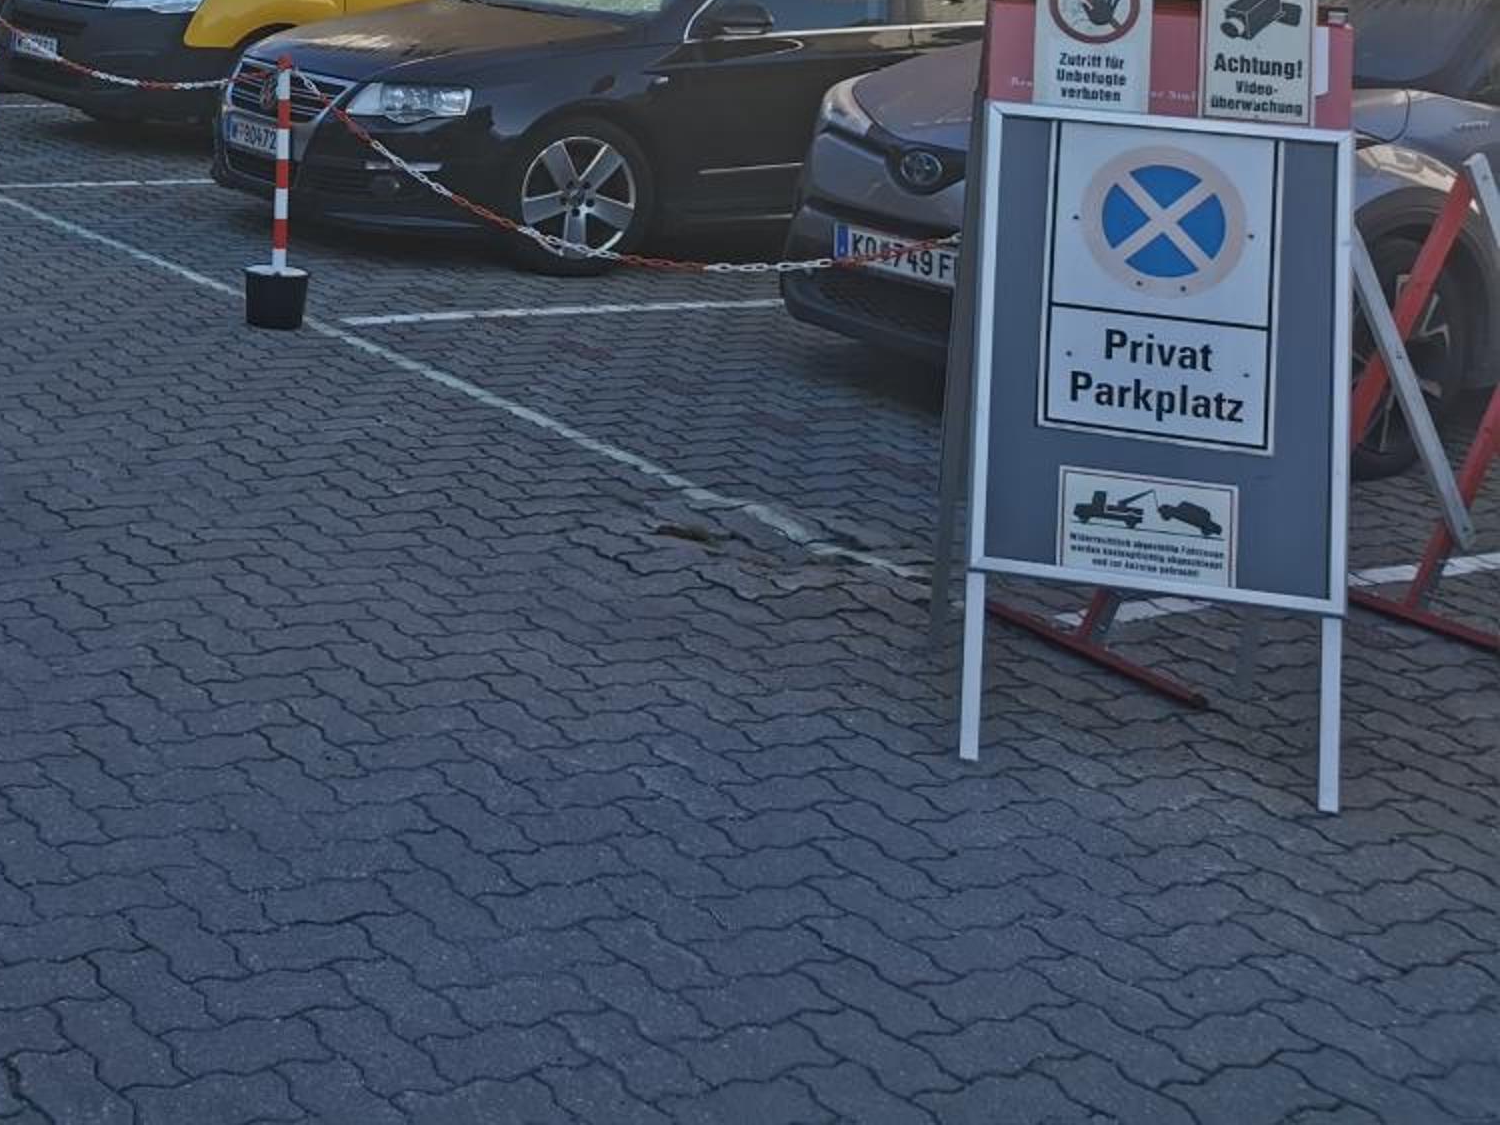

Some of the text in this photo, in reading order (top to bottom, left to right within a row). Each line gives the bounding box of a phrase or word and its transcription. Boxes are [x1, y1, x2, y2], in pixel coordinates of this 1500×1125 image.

[1059, 52, 1124, 70] Zutritt für
[1213, 52, 1303, 80] Achtung!
[1056, 68, 1127, 87] Unbefugte
[1061, 86, 1122, 102] verboten
[1236, 80, 1279, 96] Video-
[1211, 95, 1303, 117] überwachung
[1105, 328, 1213, 373] Privat
[1070, 370, 1244, 423] Parkplatz
